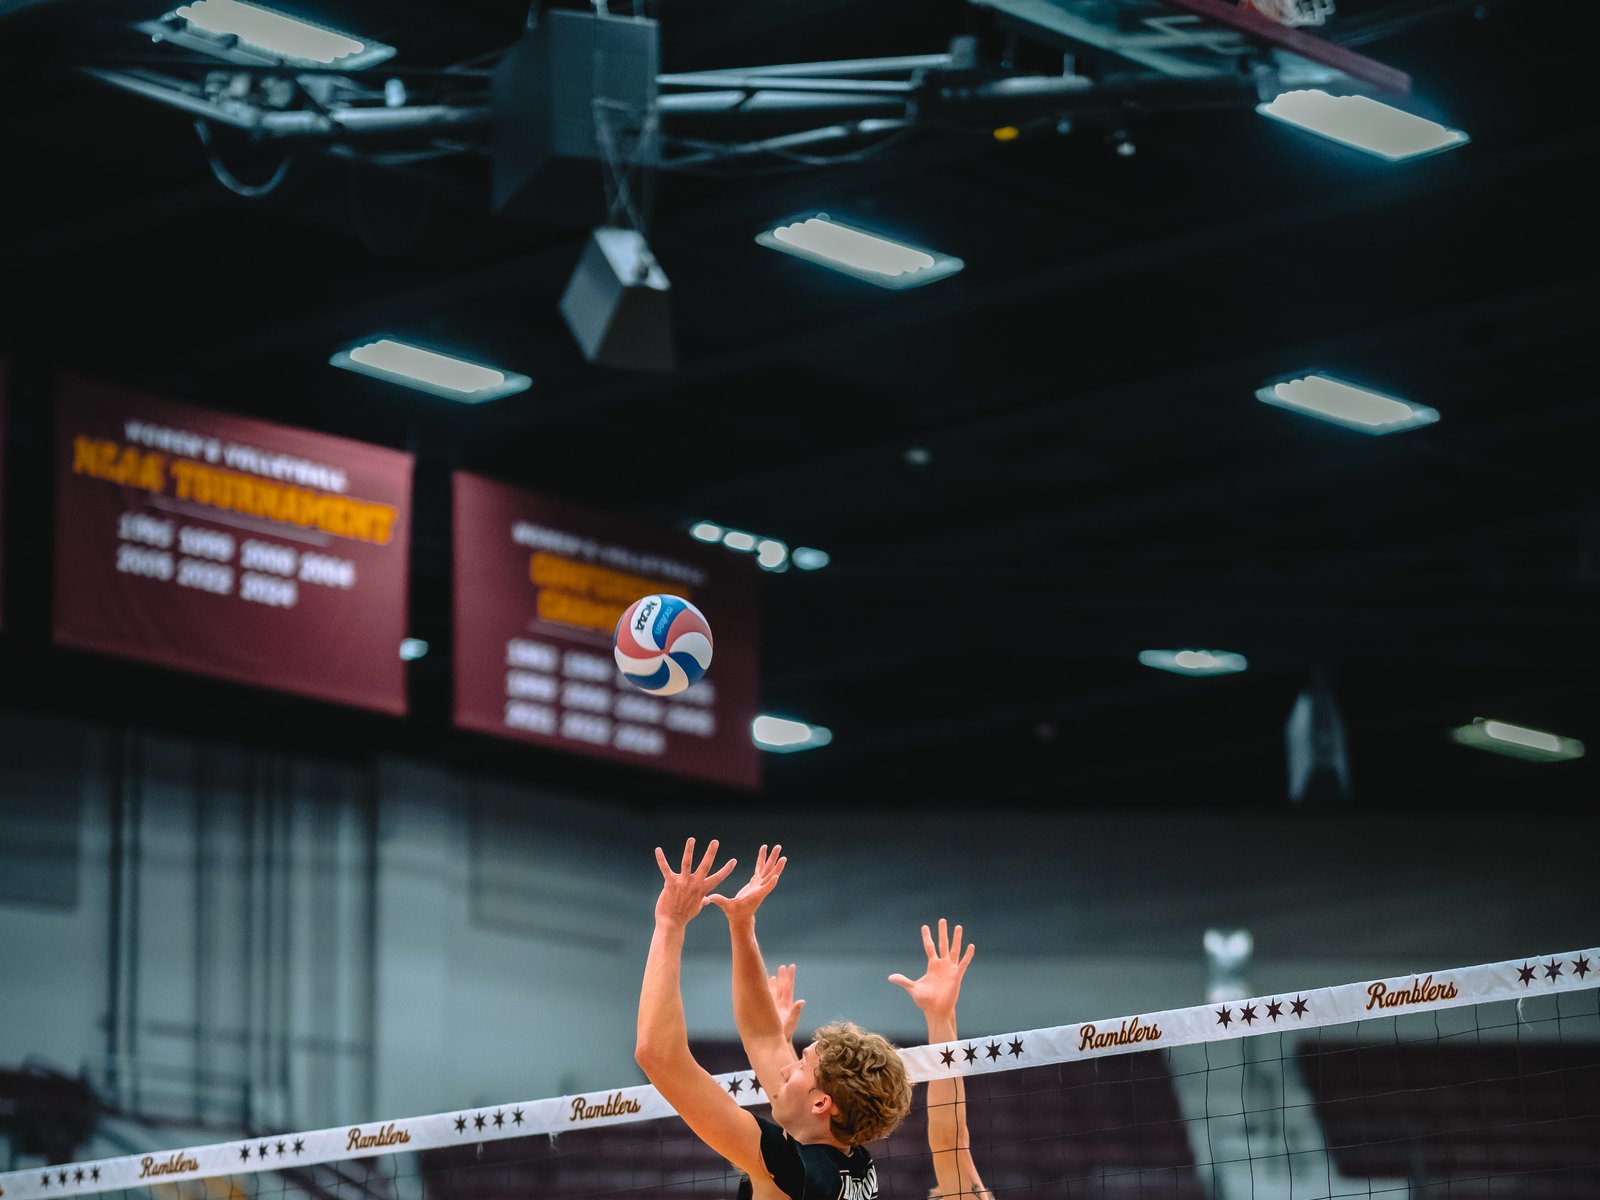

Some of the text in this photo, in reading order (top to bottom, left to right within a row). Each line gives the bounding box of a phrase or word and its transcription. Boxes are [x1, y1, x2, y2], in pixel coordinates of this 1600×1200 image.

[171, 458, 396, 545] TOURNAMENT
[635, 600, 657, 632] NCAA
[655, 606, 674, 635] molten
[1366, 975, 1459, 1011] Ramblers
[1078, 1016, 1162, 1051] Ramblers
[568, 1091, 641, 1121] Ramblers
[346, 1123, 411, 1151] Ramblers
[139, 1151, 199, 1178] Ramblers
